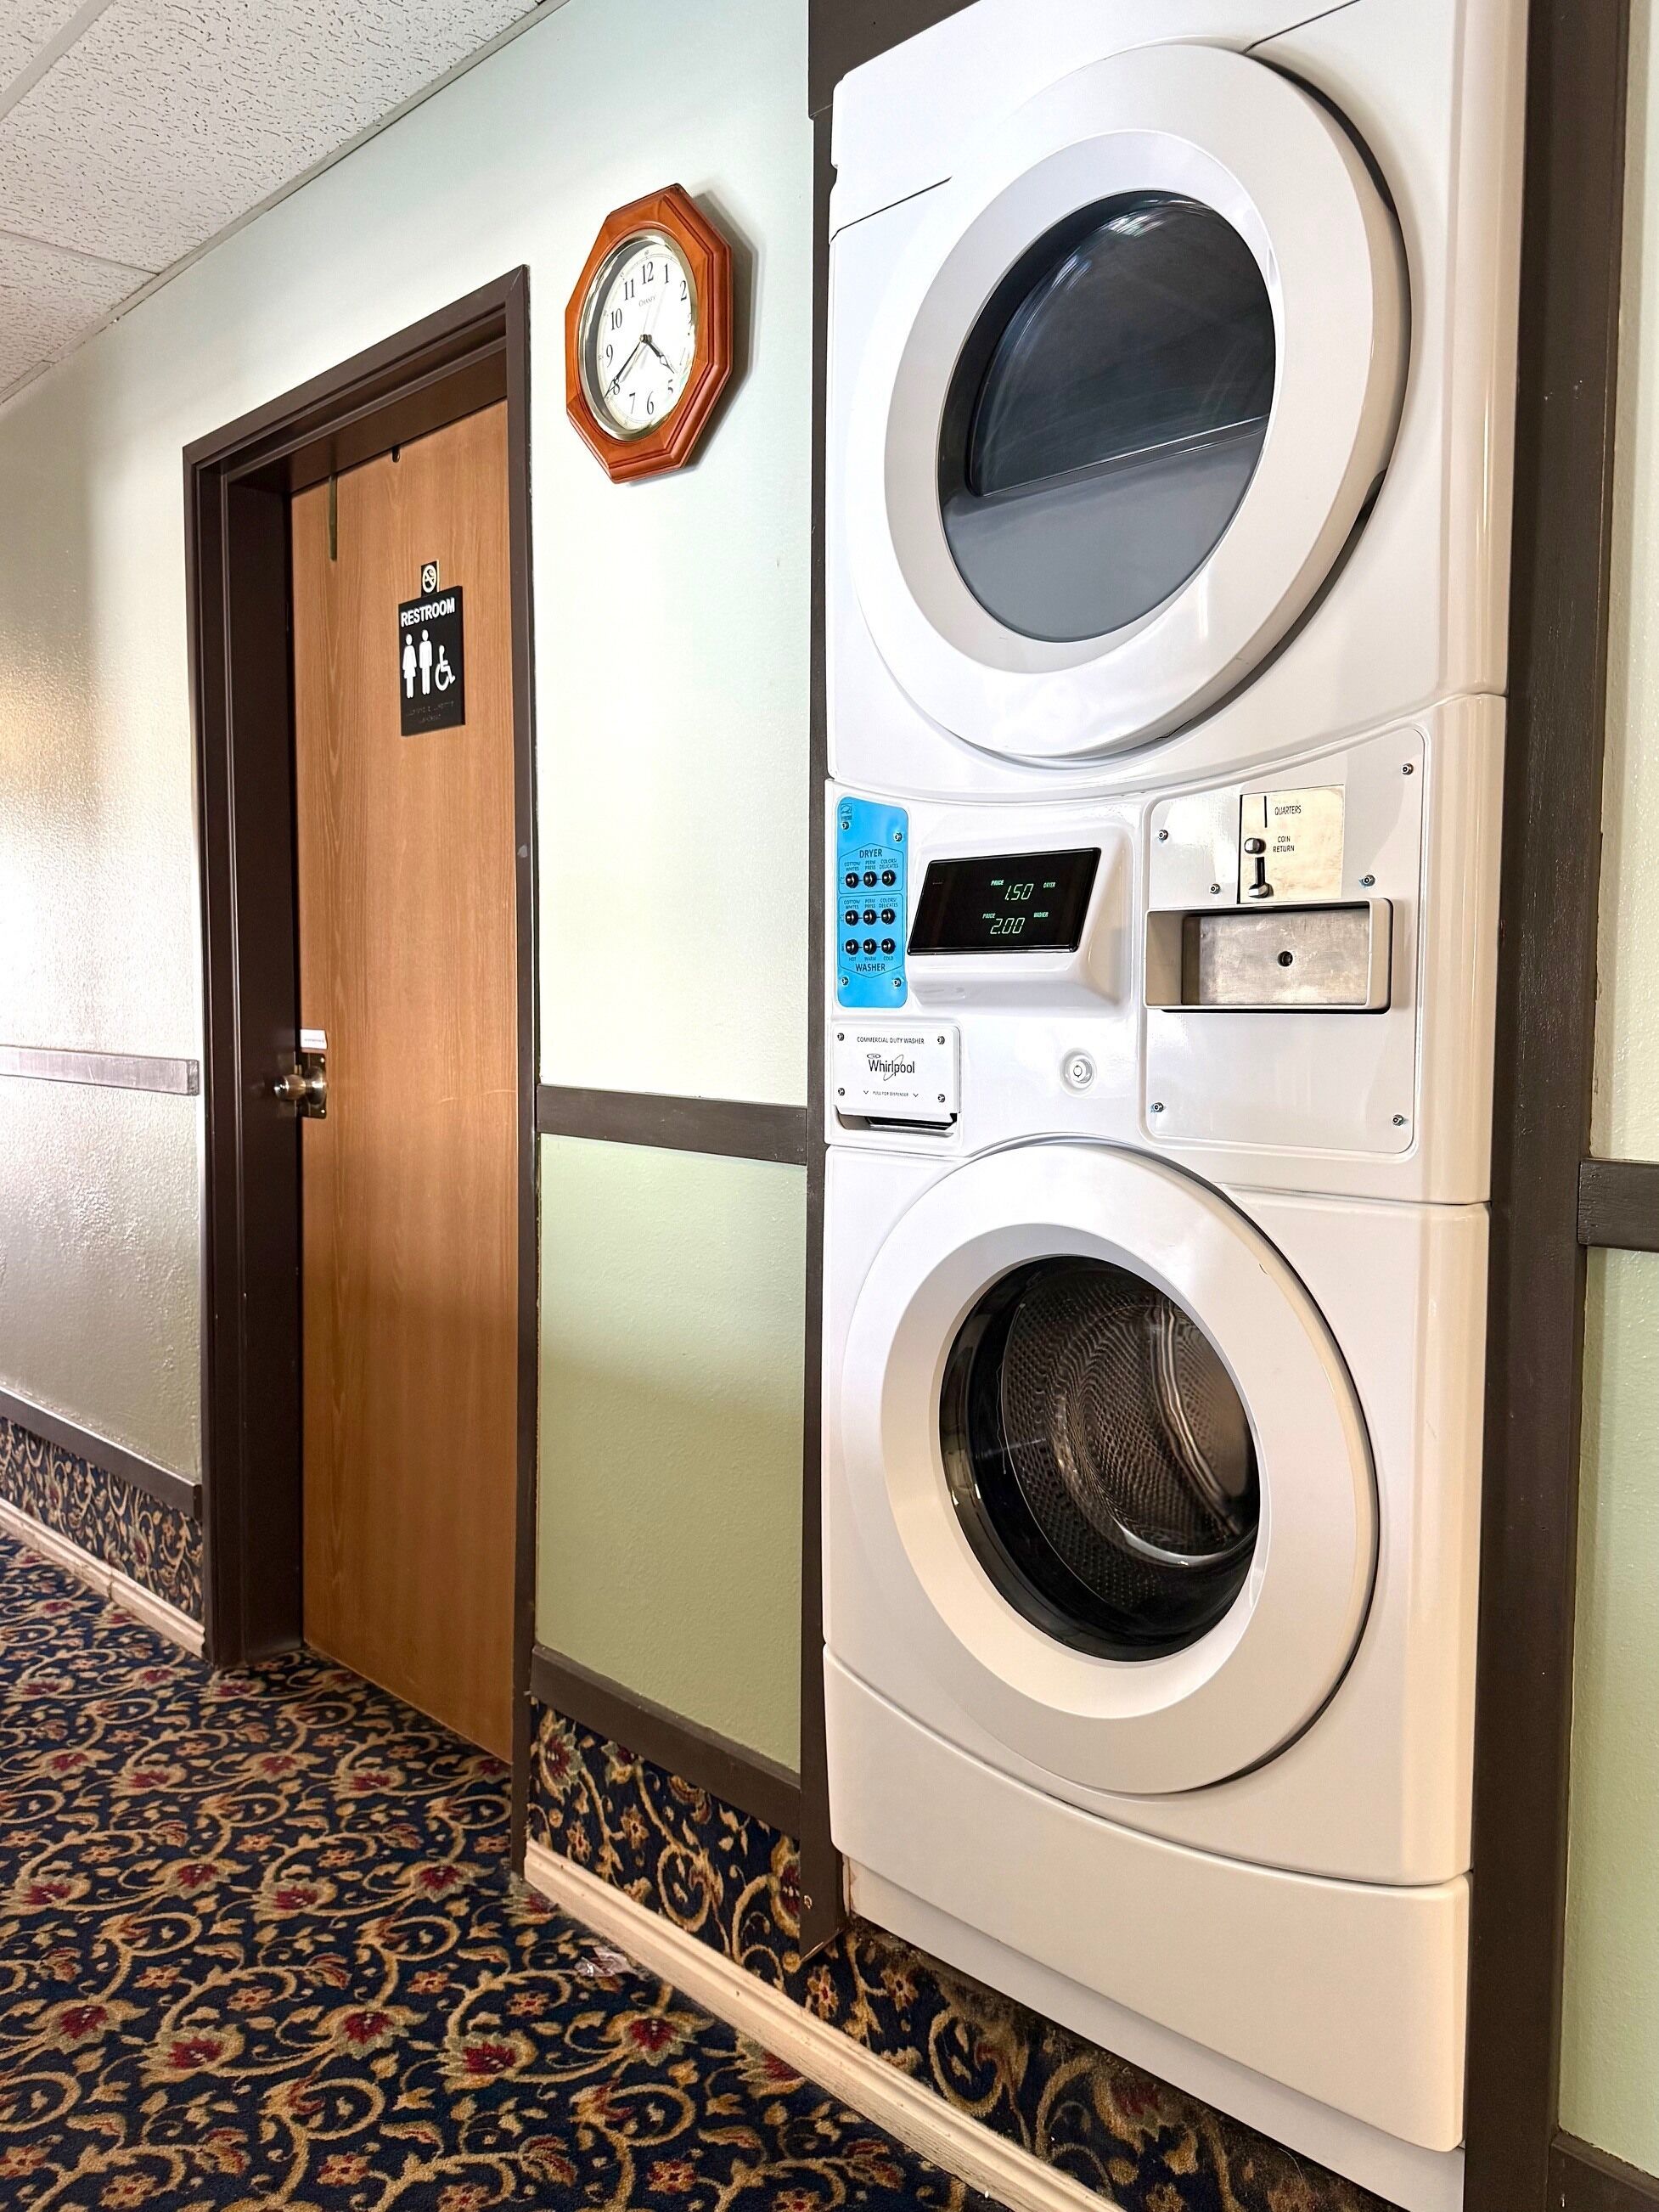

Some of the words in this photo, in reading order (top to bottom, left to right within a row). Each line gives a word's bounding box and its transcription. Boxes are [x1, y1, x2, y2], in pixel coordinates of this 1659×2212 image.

[641, 261, 654, 284] 12
[664, 262, 669, 284] 1
[624, 278, 635, 301] 11
[679, 279, 688, 301] 2
[610, 307, 622, 331] 10
[605, 344, 614, 368] 9
[628, 392, 636, 414] 7
[646, 391, 655, 415] 6
[400, 597, 456, 628] RESTROOM
[1274, 805, 1302, 815] QUARTERS
[859, 848, 883, 858] DRYER
[1004, 883, 1034, 901] 1.50
[990, 917, 1026, 935] 2.00
[855, 963, 886, 972] WASHER
[868, 1058, 915, 1077] Whirlpool
